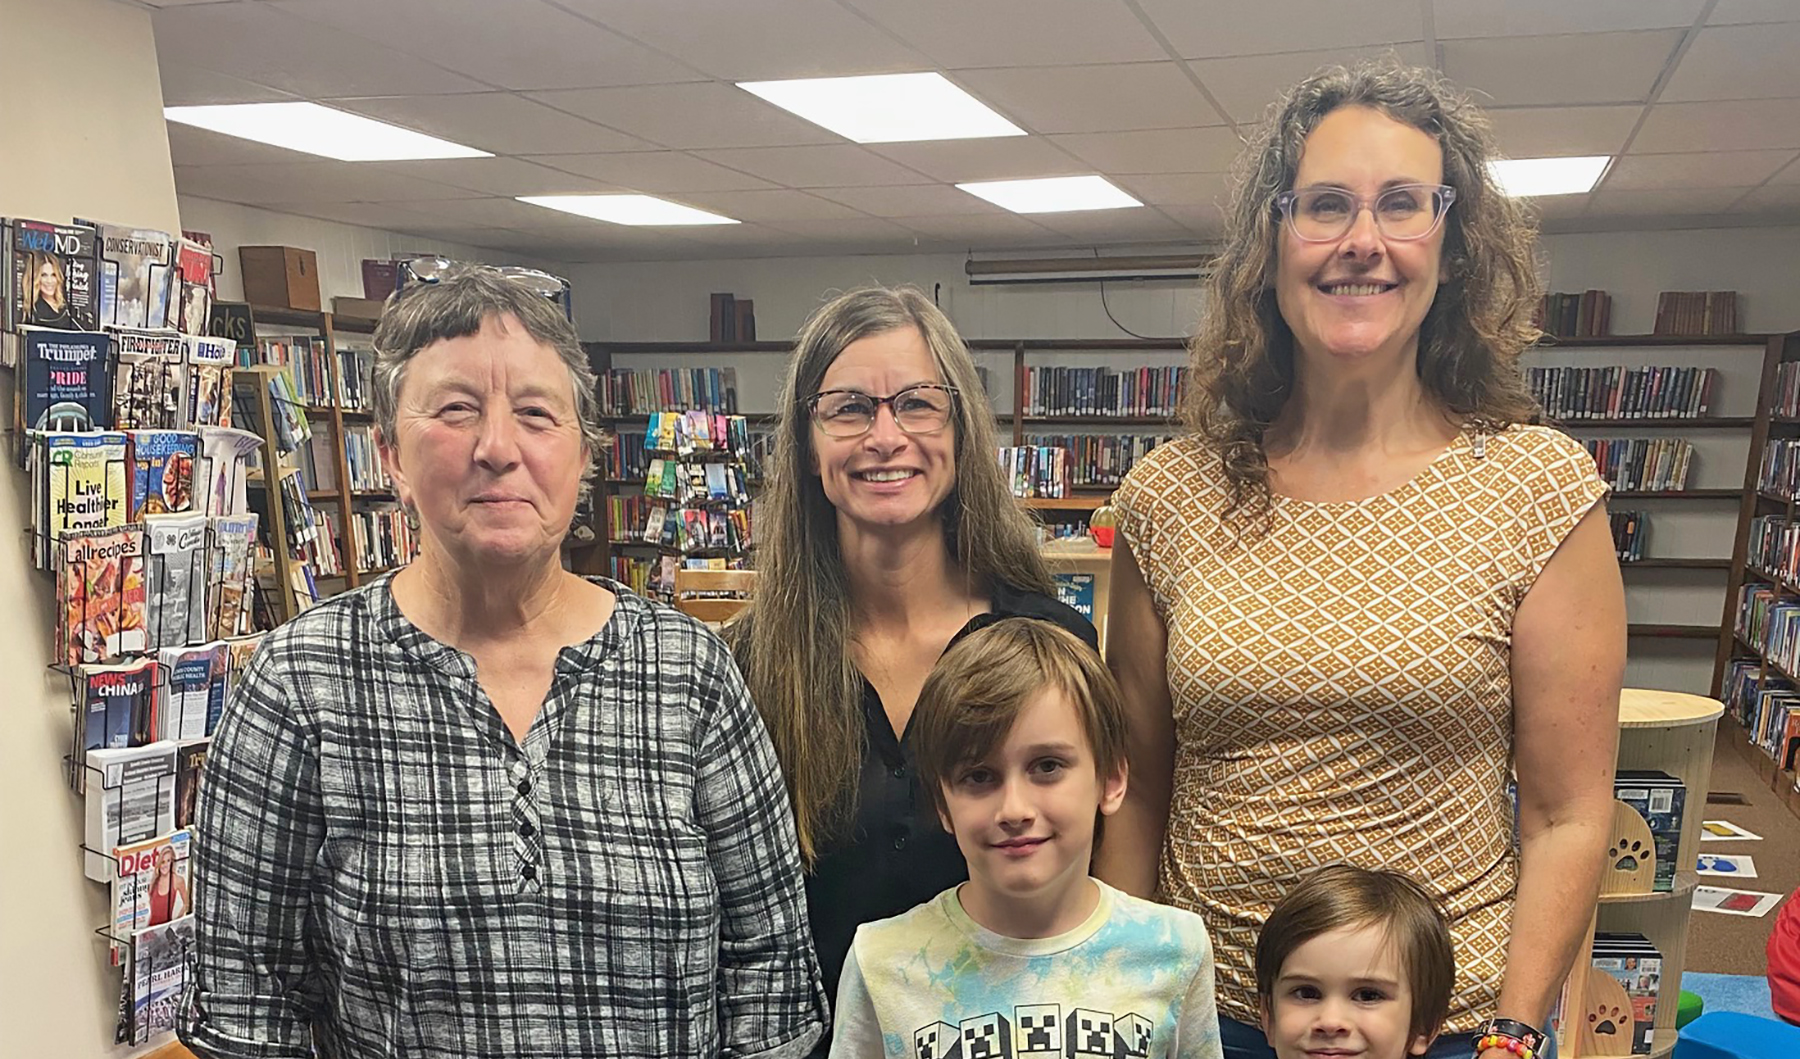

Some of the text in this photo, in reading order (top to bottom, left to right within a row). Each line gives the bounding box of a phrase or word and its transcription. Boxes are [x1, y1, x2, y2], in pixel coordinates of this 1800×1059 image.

[22, 230, 81, 255] WebMD
[154, 433, 178, 444] GOOD
[135, 443, 195, 456] HOUSEKEEPING
[52, 450, 73, 467] CR
[75, 480, 102, 495] Live
[57, 496, 119, 515] Healthier
[75, 541, 136, 562] allrecipes
[90, 672, 126, 689] NEWS
[98, 682, 138, 697] CHINA
